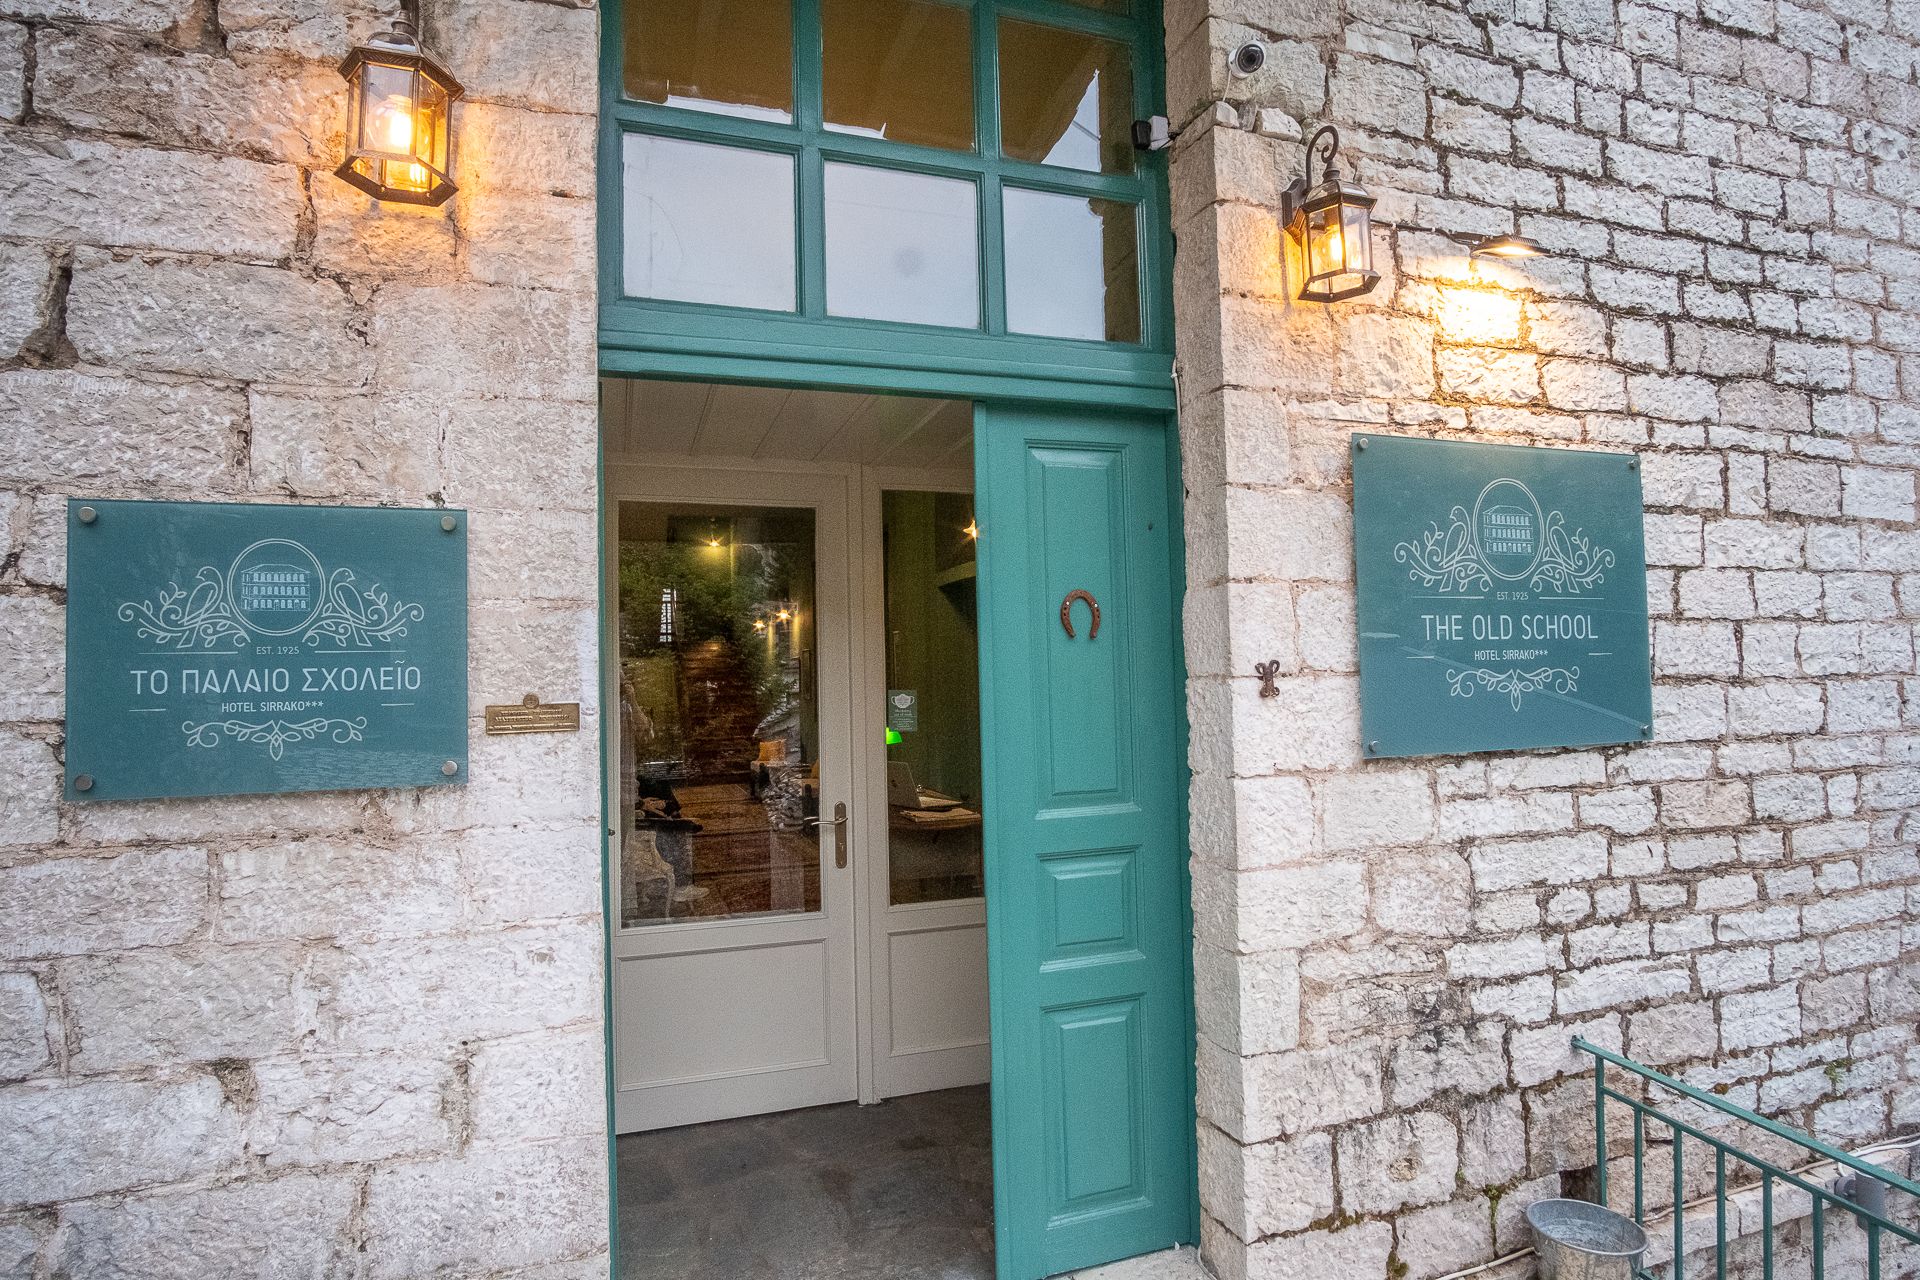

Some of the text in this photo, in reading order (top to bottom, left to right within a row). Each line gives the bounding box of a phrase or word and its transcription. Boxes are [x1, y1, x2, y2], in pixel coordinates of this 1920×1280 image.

[1496, 591, 1529, 601] EST. 1925
[1420, 614, 1599, 641] THE OLD SCHOOL
[255, 645, 300, 656] EST. 1925
[1474, 650, 1501, 661] HOTEL
[129, 669, 169, 695] ΤΟ
[181, 668, 290, 694] ΠΑΛΑΙΟ
[221, 701, 257, 713] HOTEL
